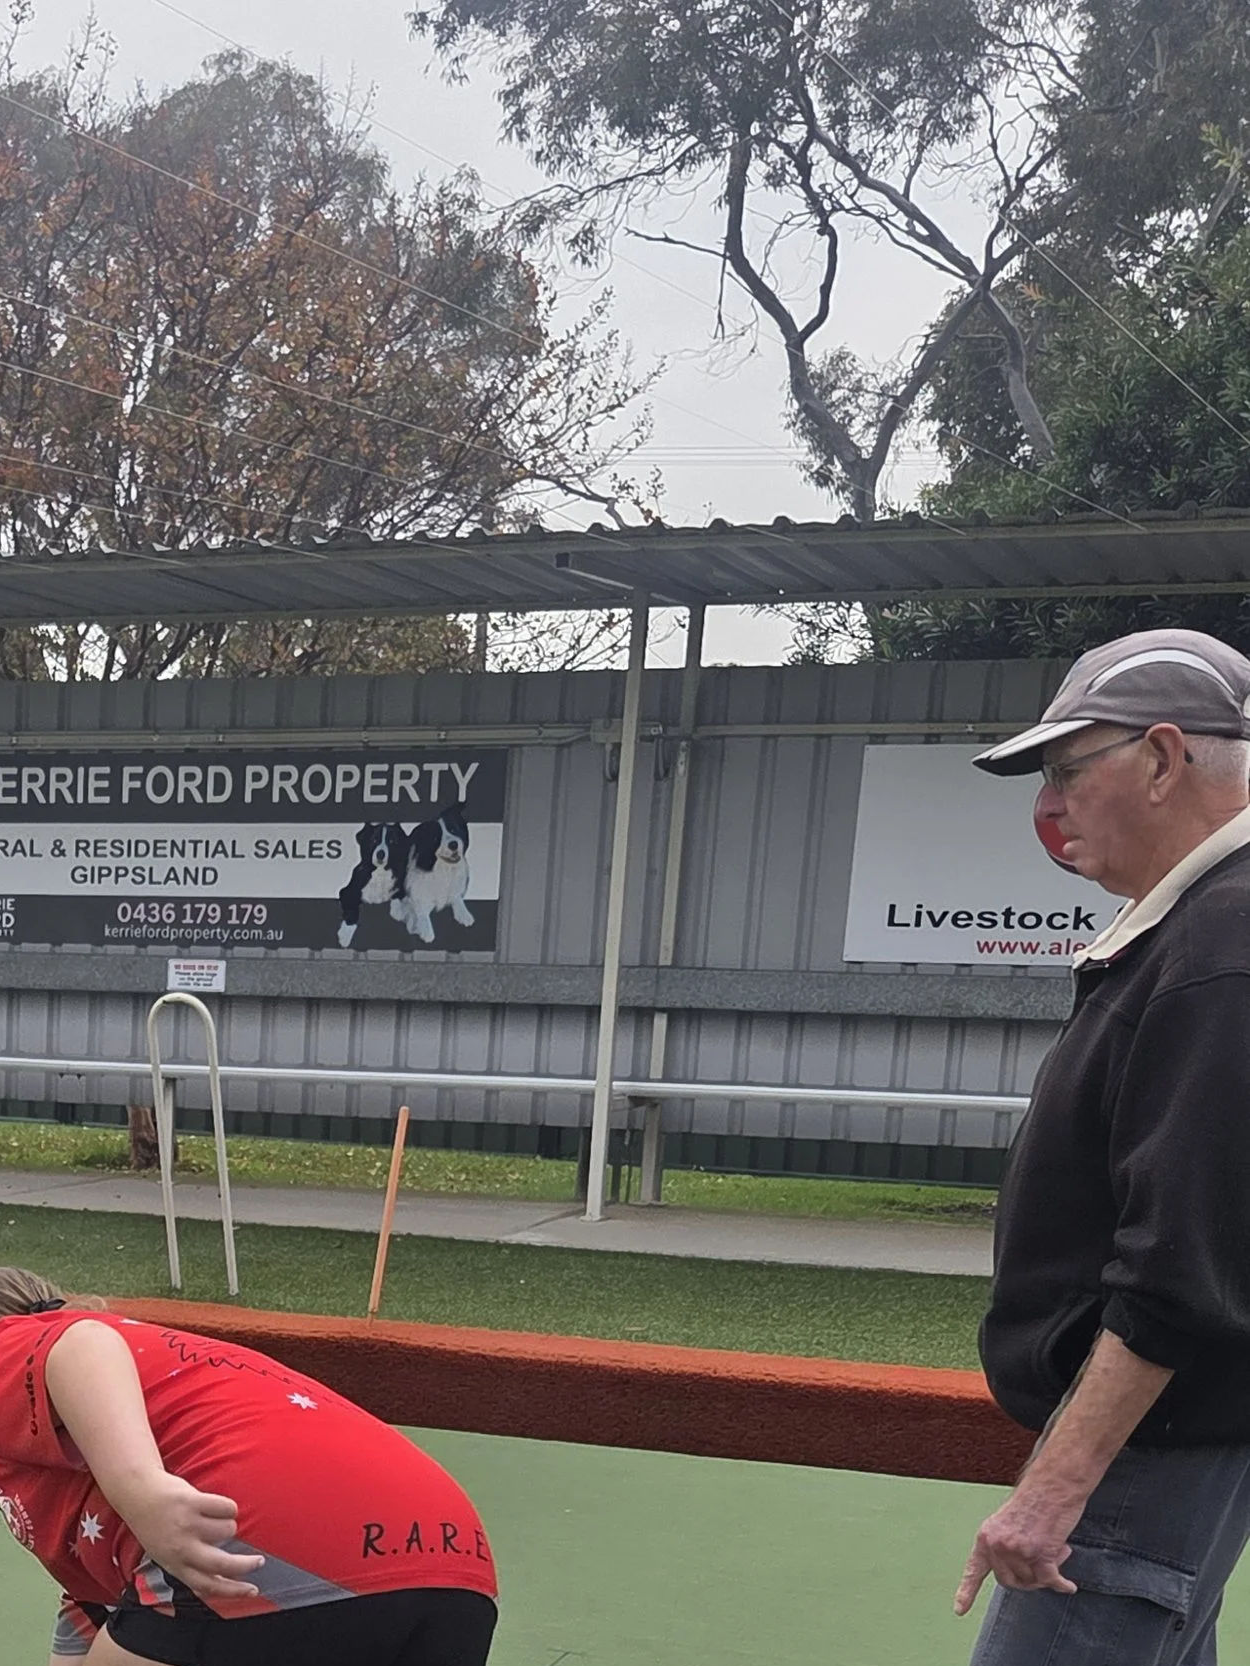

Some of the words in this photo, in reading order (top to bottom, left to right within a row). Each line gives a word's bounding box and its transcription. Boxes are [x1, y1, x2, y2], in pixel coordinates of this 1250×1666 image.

[122, 766, 232, 803] FORD
[245, 763, 479, 803] PROPERTY
[51, 839, 66, 857] &
[75, 839, 245, 858] RESIDENTIAL
[254, 840, 341, 859] SALES
[71, 866, 218, 885] GIPPSLAND
[117, 903, 175, 923] 0436
[182, 904, 221, 924] 179
[228, 904, 267, 924] 179
[887, 904, 1096, 931] Livestock
[105, 924, 283, 942] kerriefordproperty.com.au
